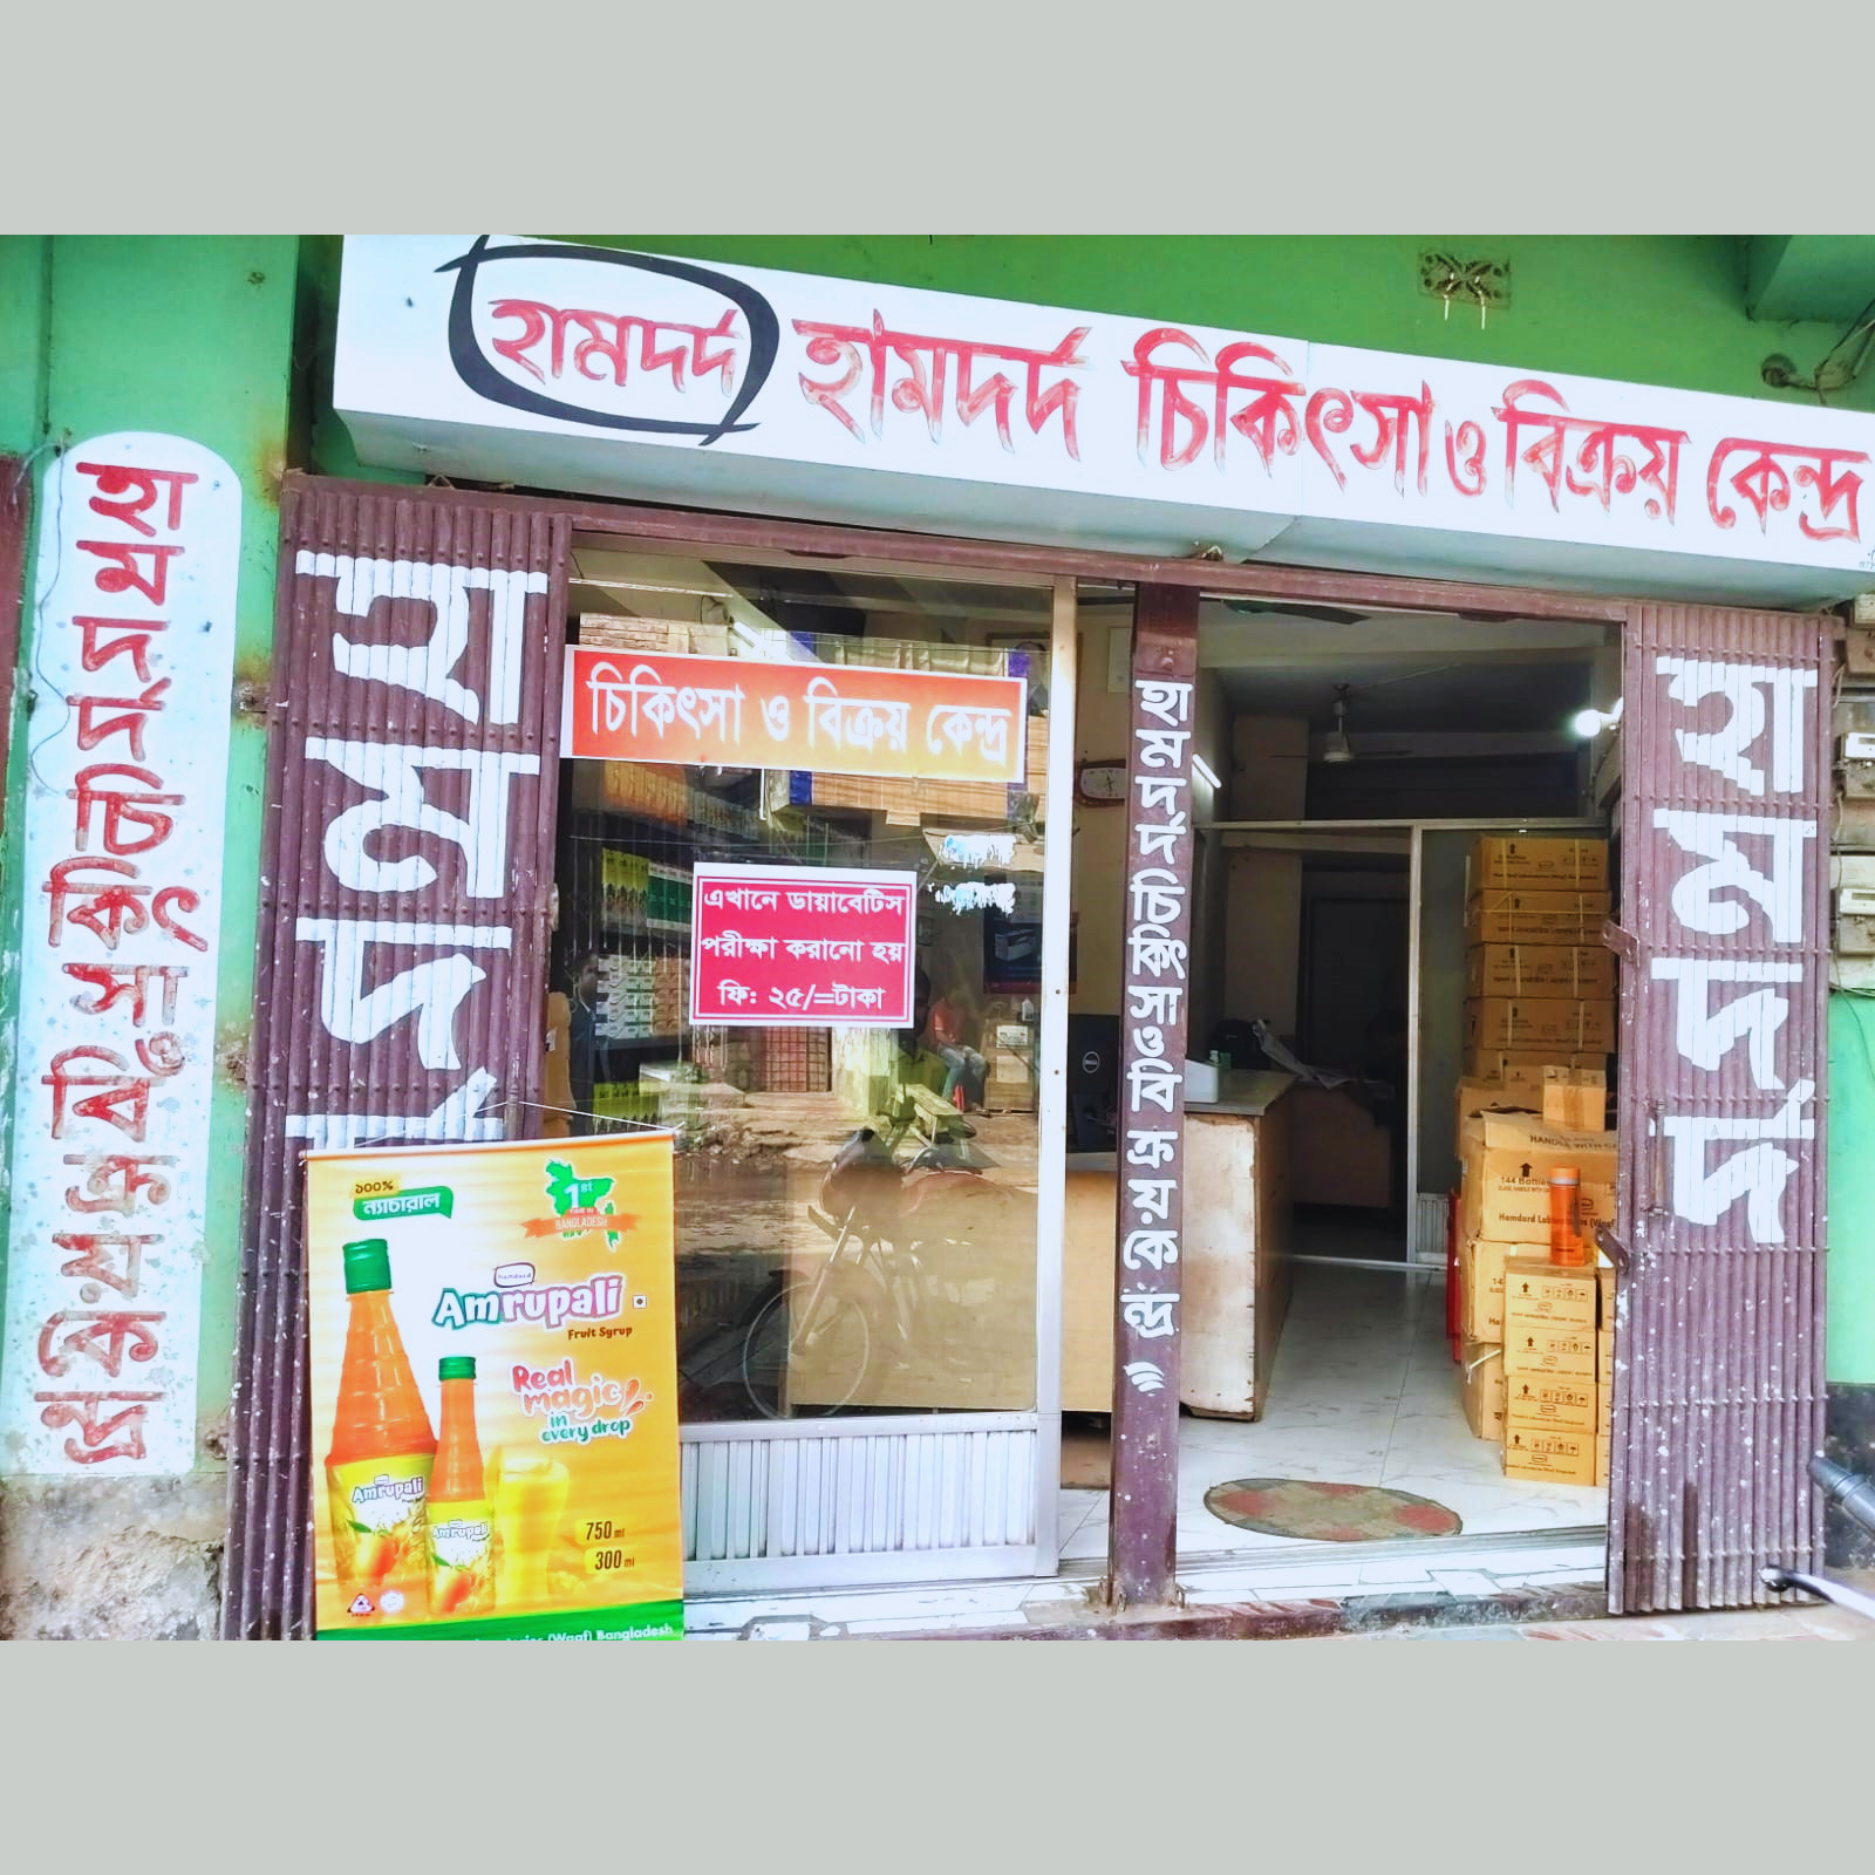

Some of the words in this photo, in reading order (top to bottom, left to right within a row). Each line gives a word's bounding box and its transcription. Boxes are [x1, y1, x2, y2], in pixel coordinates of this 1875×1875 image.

[488, 298, 744, 397] হামদর্দ
[792, 308, 1093, 462] হামদর্দ
[1120, 327, 1436, 499] চিকিৎসা
[1444, 418, 1488, 498] ও
[1492, 378, 1692, 527] বিক্রয়
[1707, 436, 1872, 544] কেন্দ্র
[586, 660, 745, 745] চিকিৎসা
[760, 693, 791, 742] ও
[803, 676, 911, 756] বিক্রয়
[926, 704, 1013, 768] কেন্দ্র
[704, 887, 780, 912] এখানে
[786, 887, 905, 915] ডায়াবেটিস
[701, 929, 779, 960] পরীক্ষা
[784, 938, 865, 963] করানো
[871, 940, 906, 965] হয়
[362, 1192, 441, 1215] ন্যাচারাল
[555, 1217, 607, 1230] BANGLADESH
[431, 1275, 623, 1330] Amrupali
[568, 1327, 596, 1340] Fruit
[599, 1326, 632, 1339] Syrup
[512, 1359, 573, 1393] Real
[523, 1375, 621, 1418] magic
[541, 1425, 589, 1442] every
[592, 1419, 630, 1435] drop
[550, 1411, 567, 1427] in
[352, 1476, 424, 1503] Amrupali
[586, 1520, 612, 1540] 750
[595, 1549, 622, 1570] 300
[596, 1622, 673, 1640] Bangladesh
